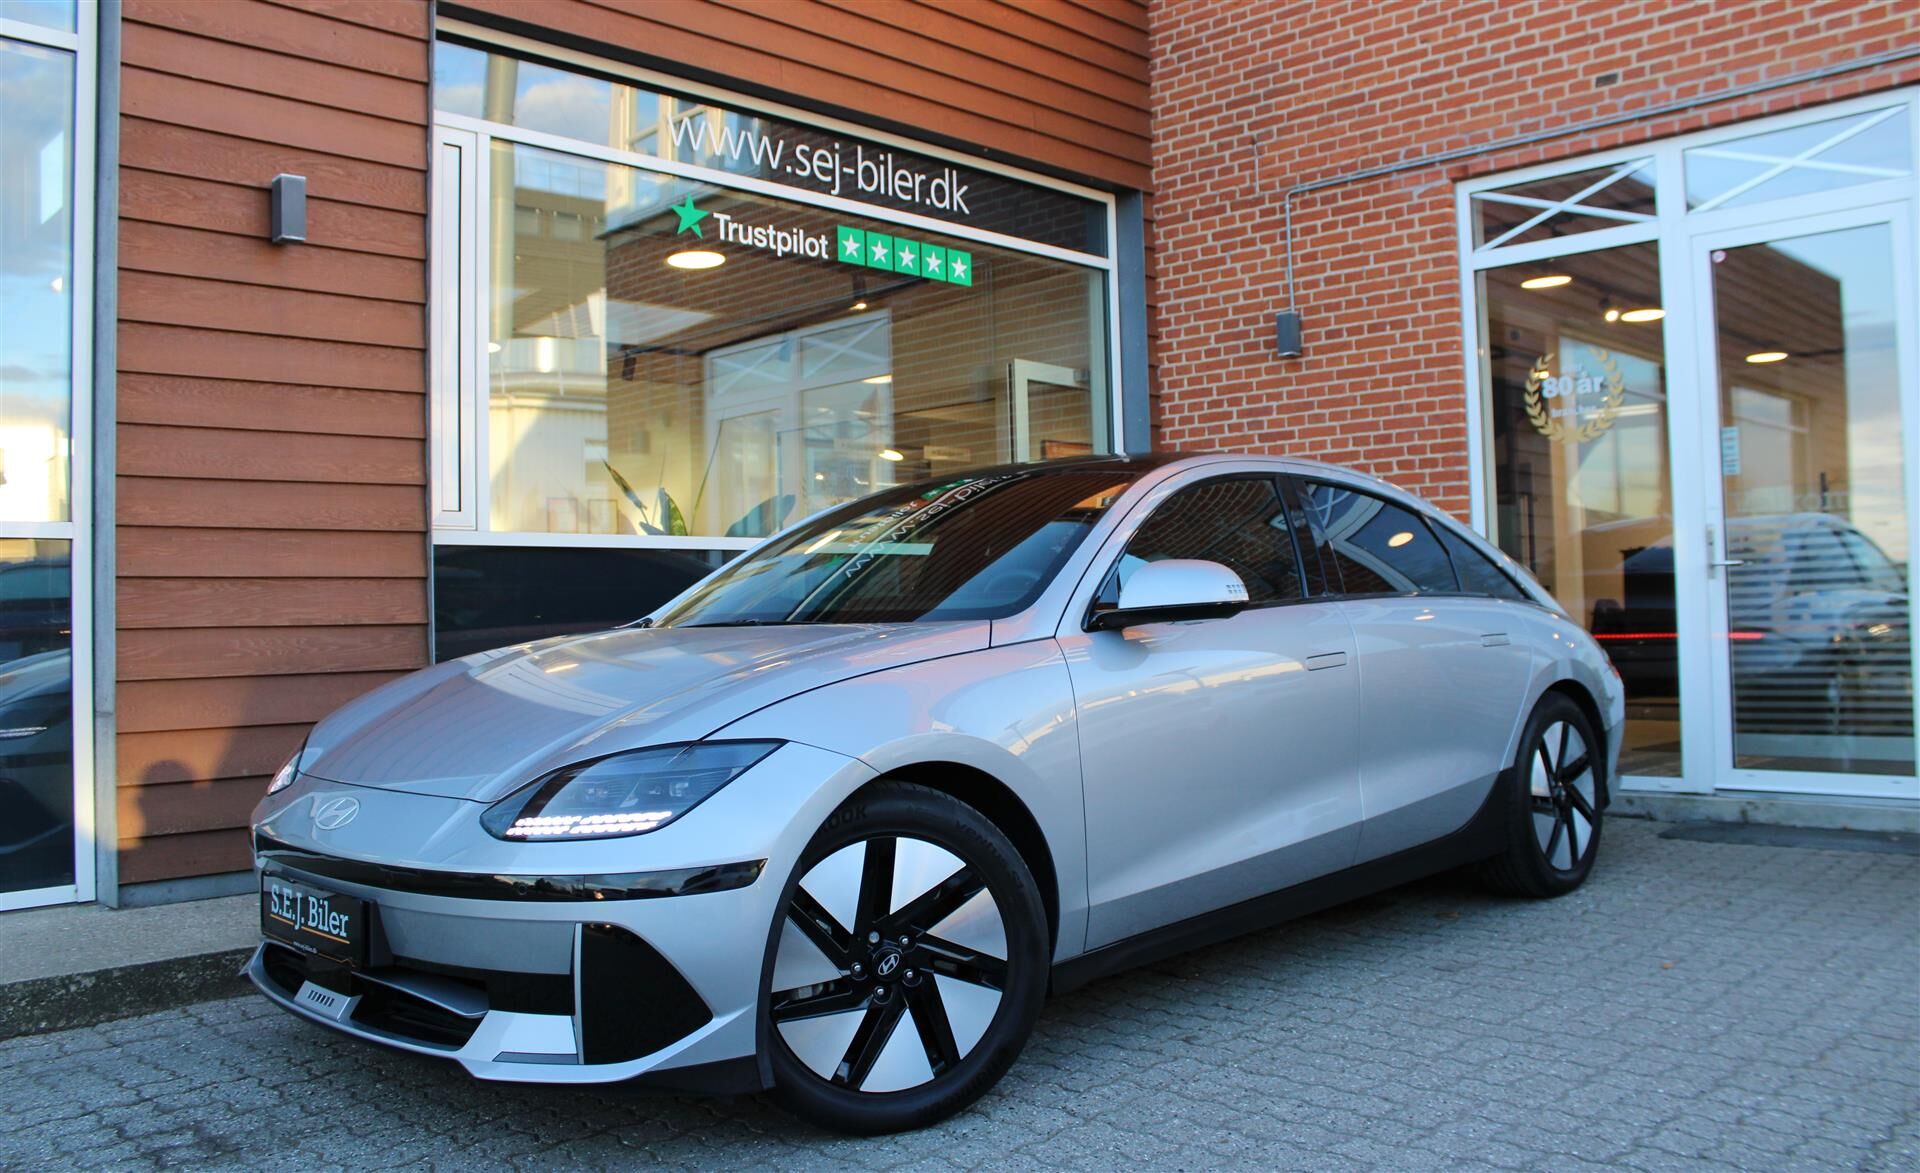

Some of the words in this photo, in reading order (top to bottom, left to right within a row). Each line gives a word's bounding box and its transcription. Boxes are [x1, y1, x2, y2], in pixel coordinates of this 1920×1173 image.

[667, 113, 971, 215] www.sej-biler.dk
[713, 211, 829, 259] Trustpilot
[1541, 375, 1575, 399] 80
[270, 884, 305, 930] S.E.J.
[307, 896, 349, 938] Biler
